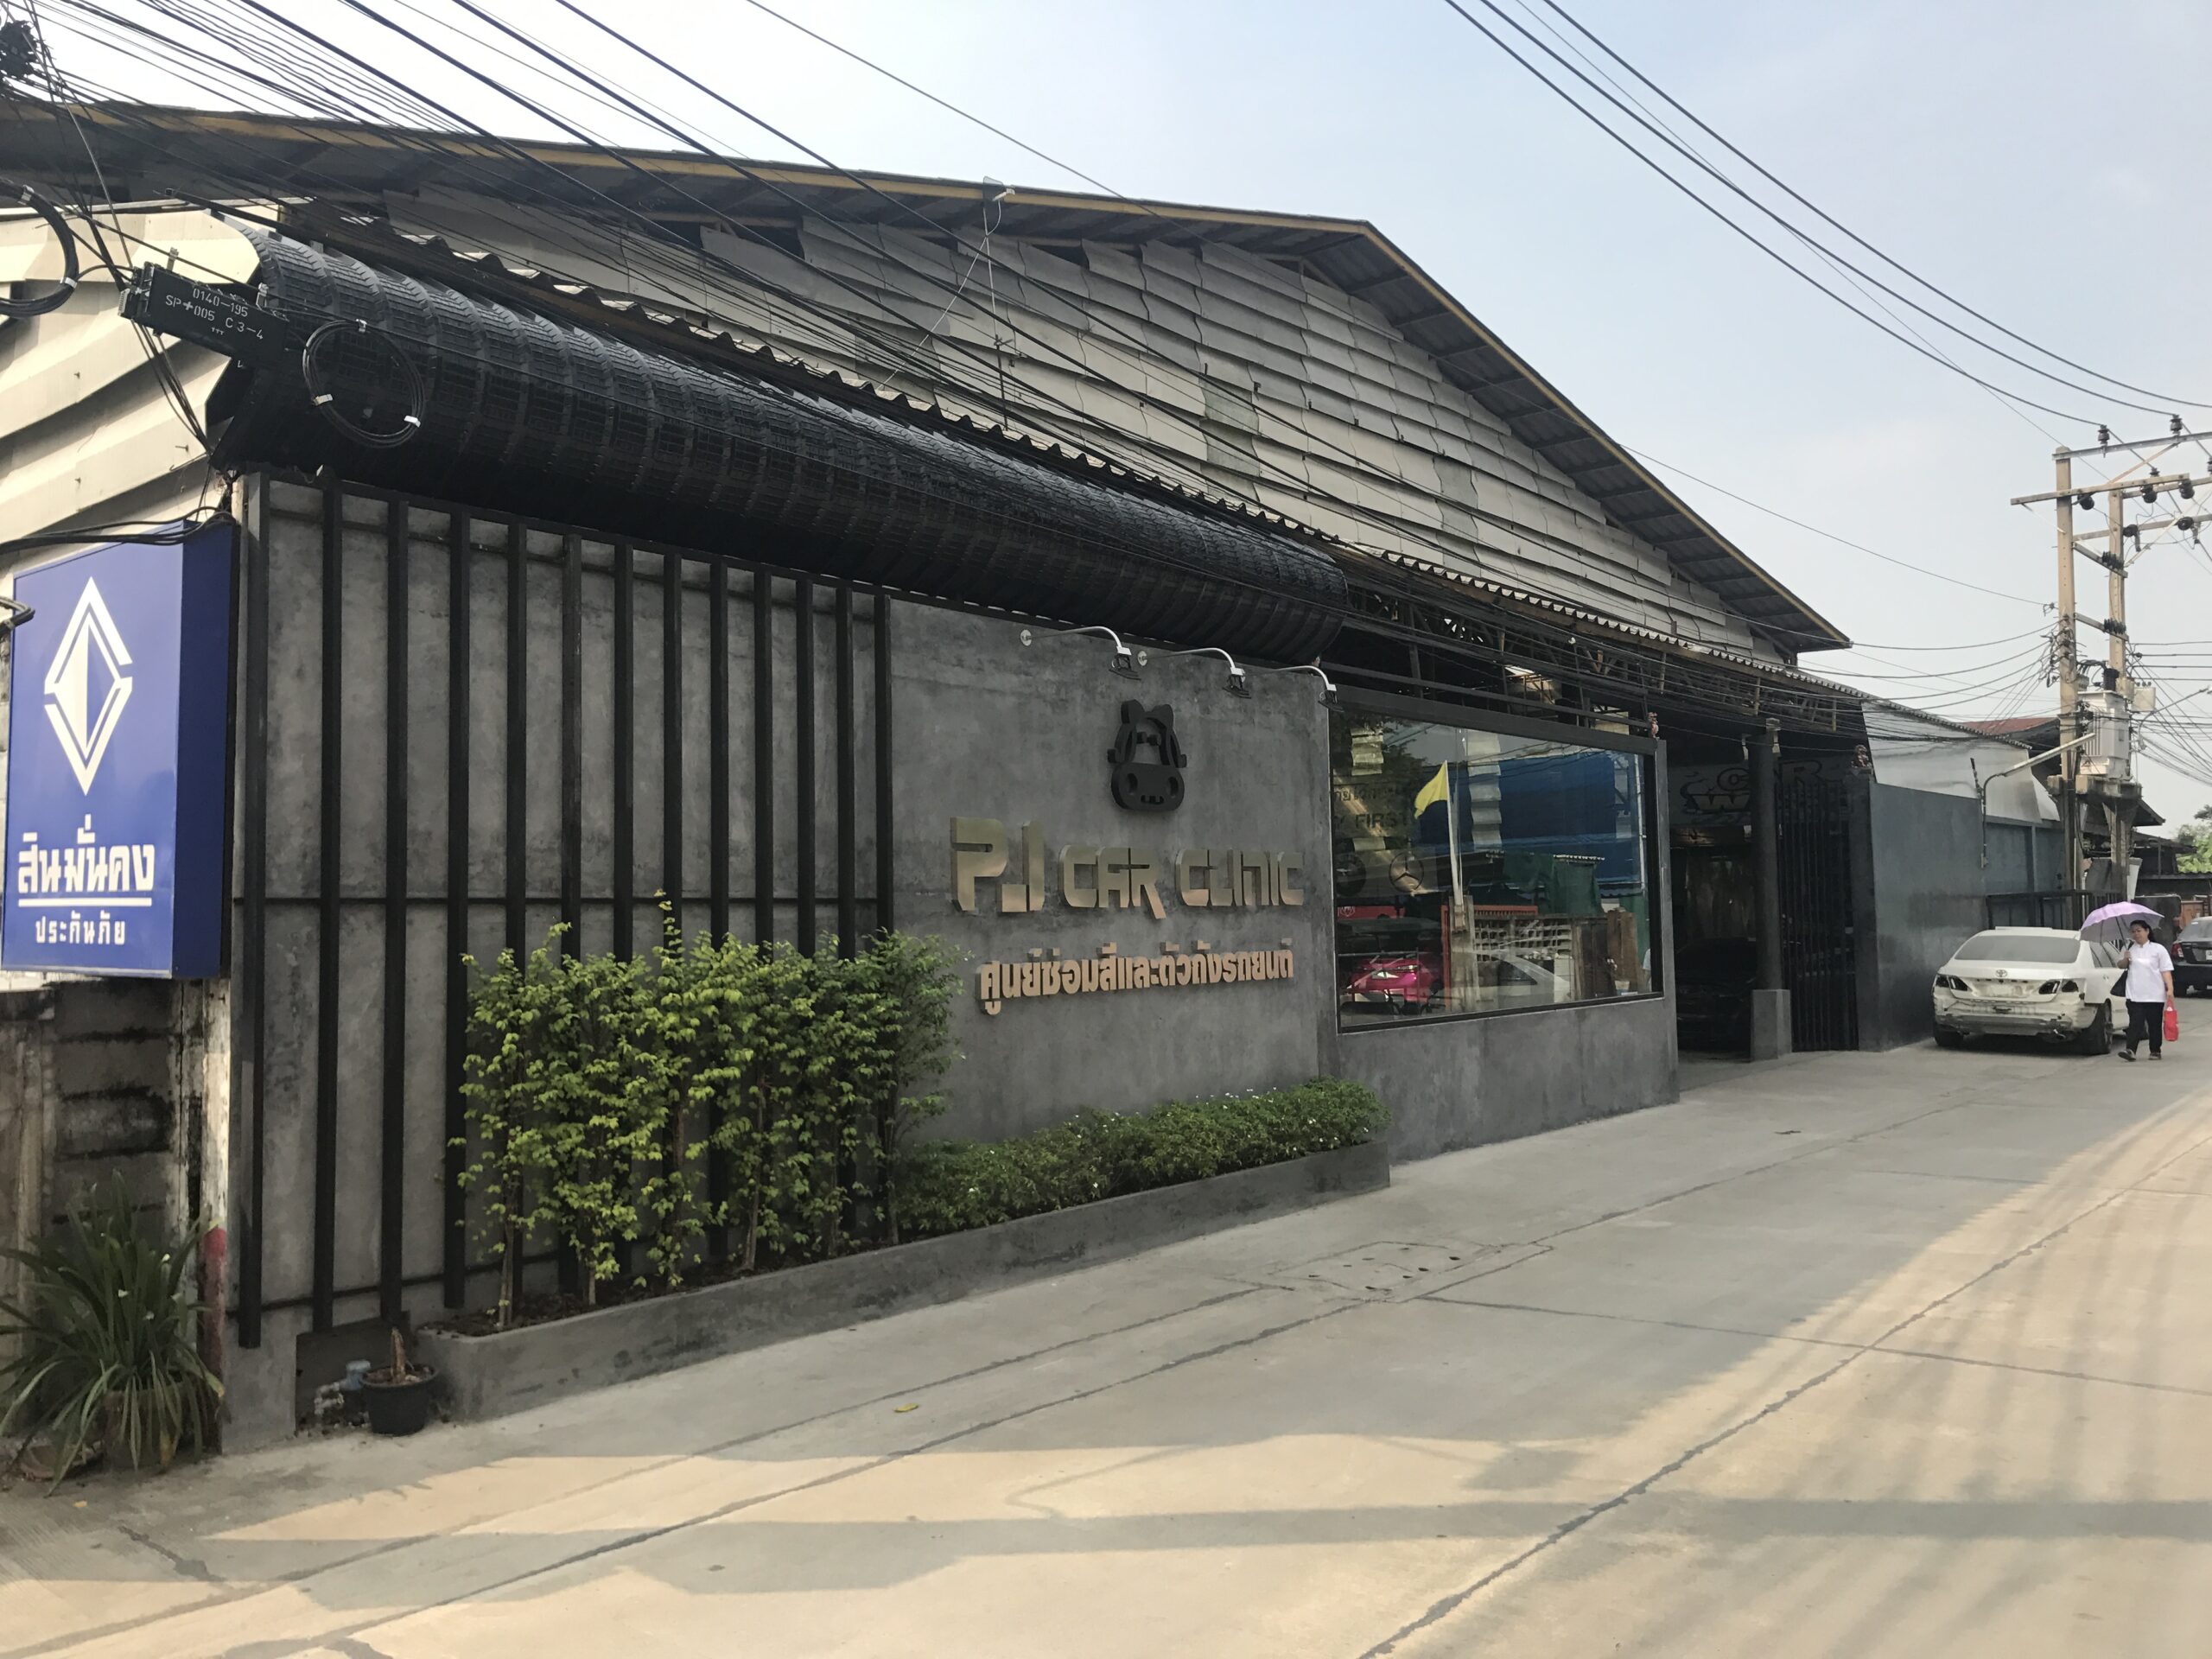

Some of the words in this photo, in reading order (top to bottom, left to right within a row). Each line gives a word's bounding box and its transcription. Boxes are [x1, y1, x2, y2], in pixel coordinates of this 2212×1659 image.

[193, 288, 248, 317] 0140-195
[18, 813, 156, 893] สินมั่นคง
[1058, 844, 1166, 919] CAR
[1175, 848, 1305, 907] CLINIC
[35, 909, 125, 945] ประกันภัย
